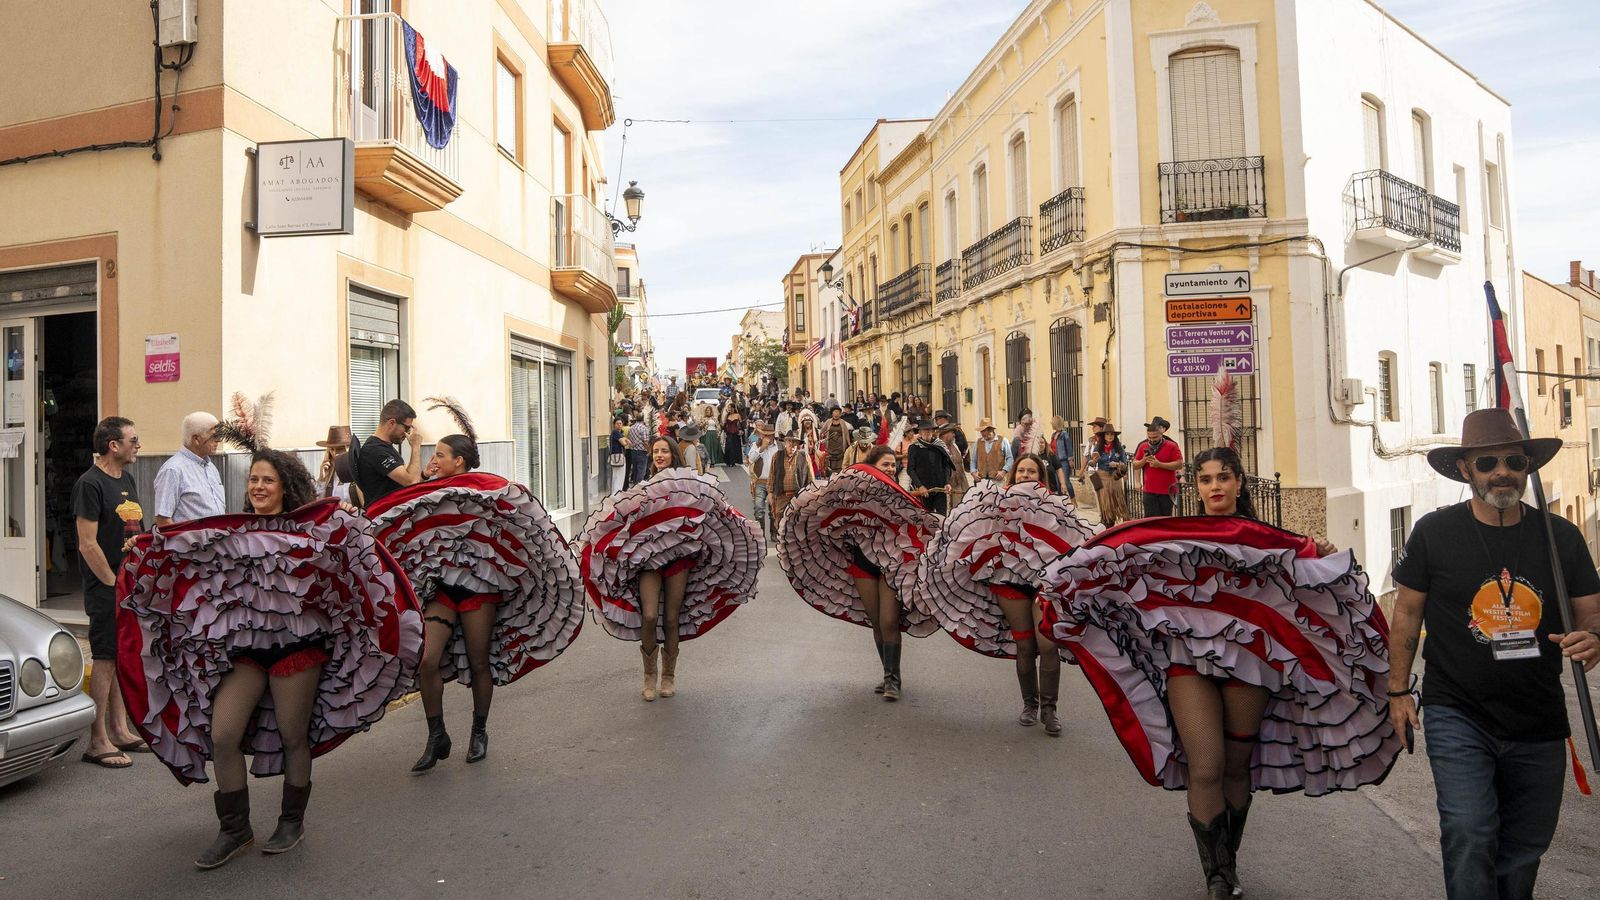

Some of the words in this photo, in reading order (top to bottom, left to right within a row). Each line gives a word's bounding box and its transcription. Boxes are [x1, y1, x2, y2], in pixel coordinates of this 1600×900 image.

[306, 156, 325, 168] AA
[290, 176, 339, 185] ABOGADOS
[1169, 279, 1228, 289] ayuntamiento
[1170, 310, 1217, 319] deportivas
[1172, 356, 1206, 364] castillo
[148, 359, 176, 374] seldis
[1183, 364, 1210, 372] XII-XVI)
